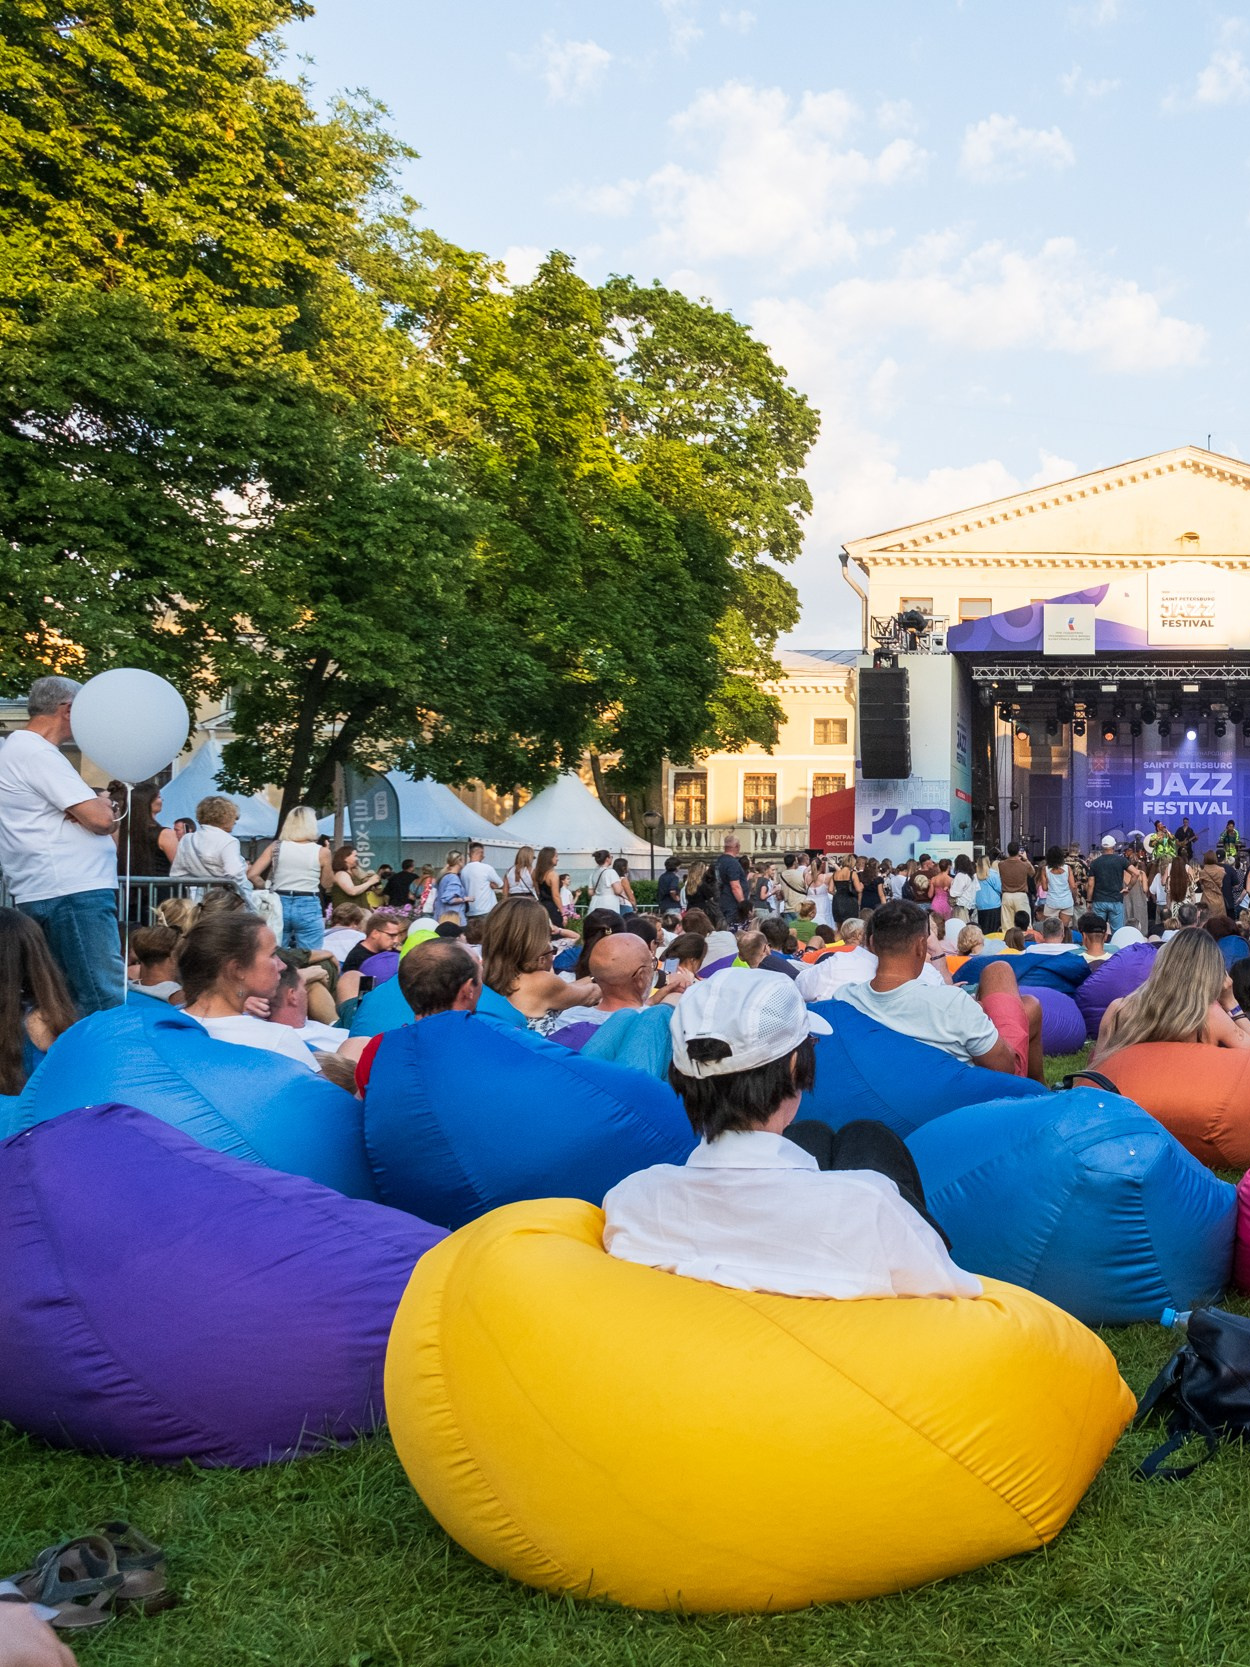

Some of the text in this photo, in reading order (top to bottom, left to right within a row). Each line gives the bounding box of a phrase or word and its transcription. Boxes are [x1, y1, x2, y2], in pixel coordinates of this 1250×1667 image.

[1160, 603, 1216, 618] JAZZ
[1161, 619, 1214, 627] FESTIVAL
[1143, 761, 1233, 769] SAINT PETERSBURG
[1143, 772, 1233, 797] JAZZ
[1084, 800, 1113, 809] ФОНД
[1142, 801, 1233, 815] FESTIVAL
